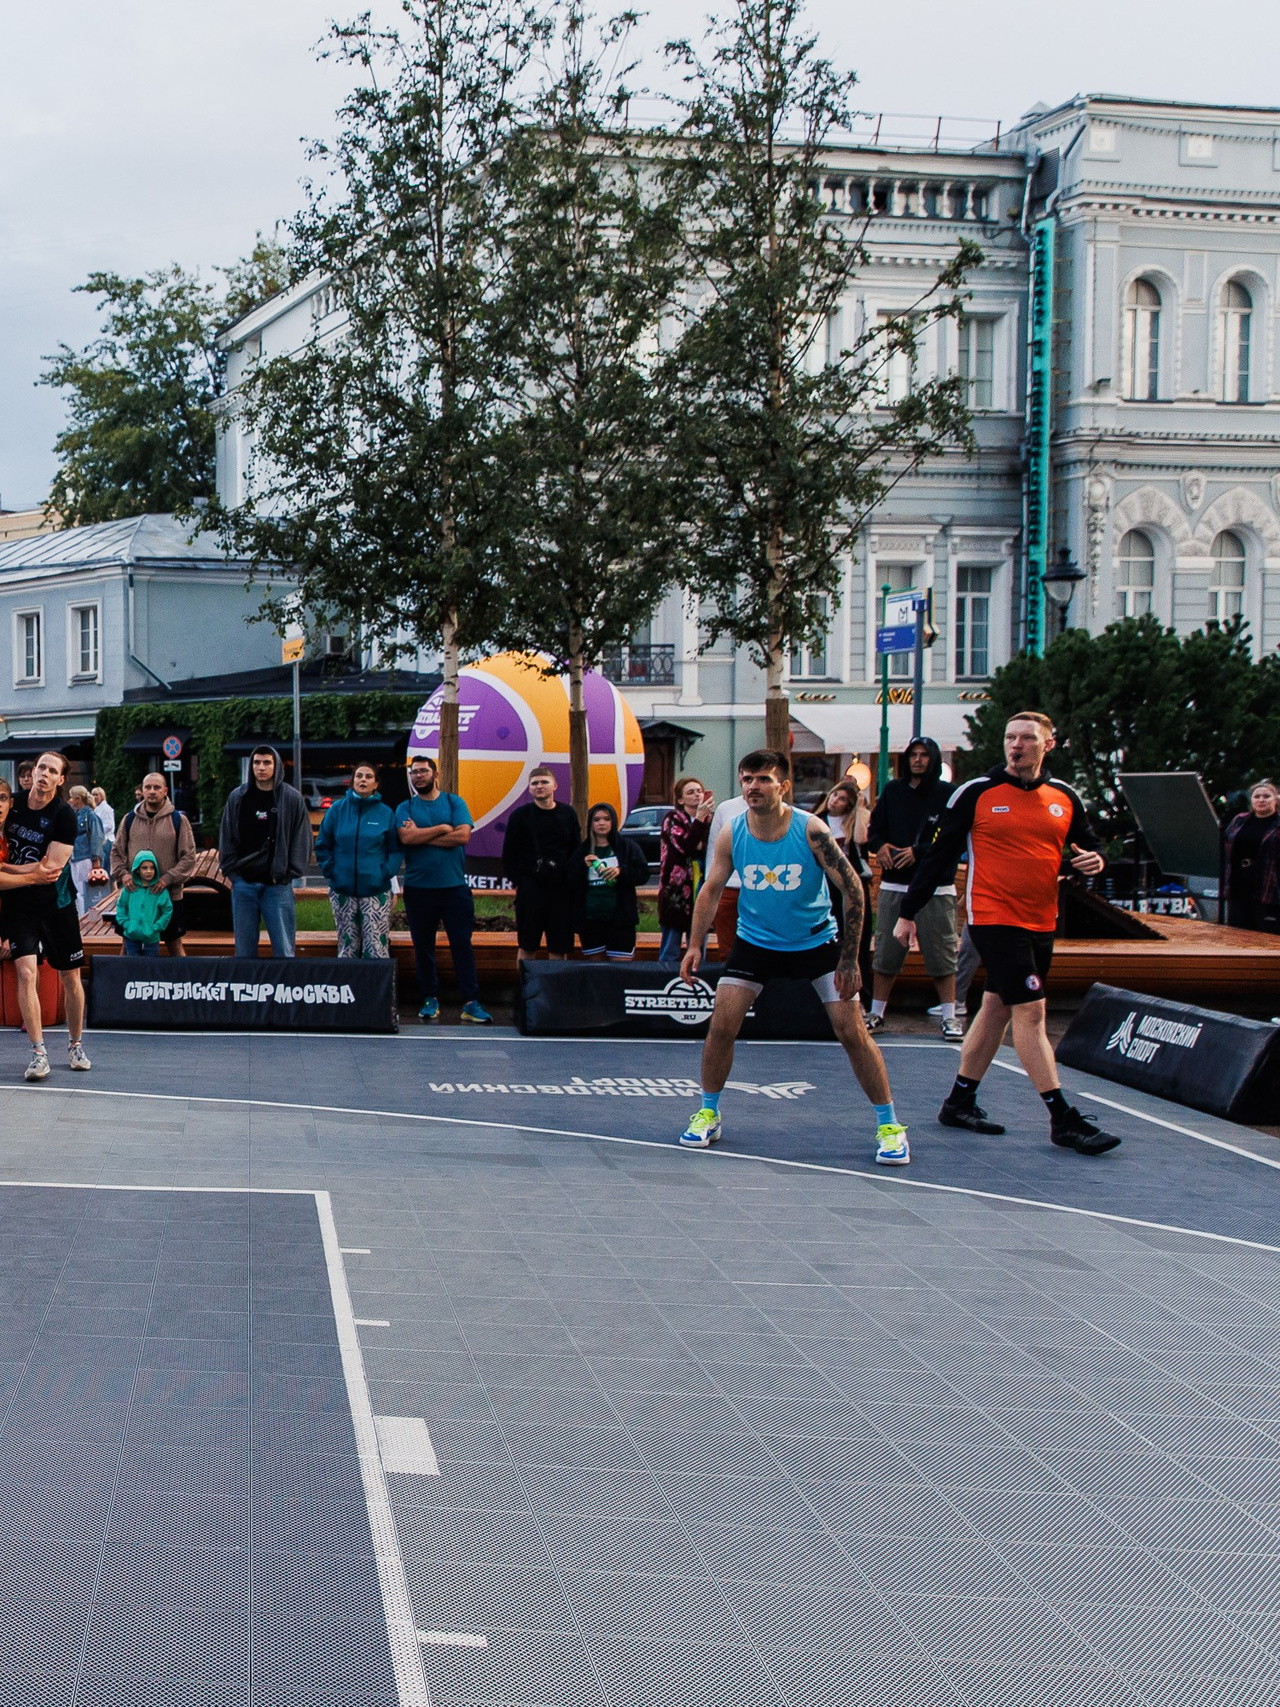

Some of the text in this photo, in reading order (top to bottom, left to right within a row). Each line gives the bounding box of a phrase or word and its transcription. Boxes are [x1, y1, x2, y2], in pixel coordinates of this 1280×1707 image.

[124, 981, 356, 1004] СТРИТБАСКЕТ ТУР МОСКВА
[1136, 1014, 1203, 1049] МОСКОВСКИЙ
[1125, 1038, 1161, 1064] СПОРТ
